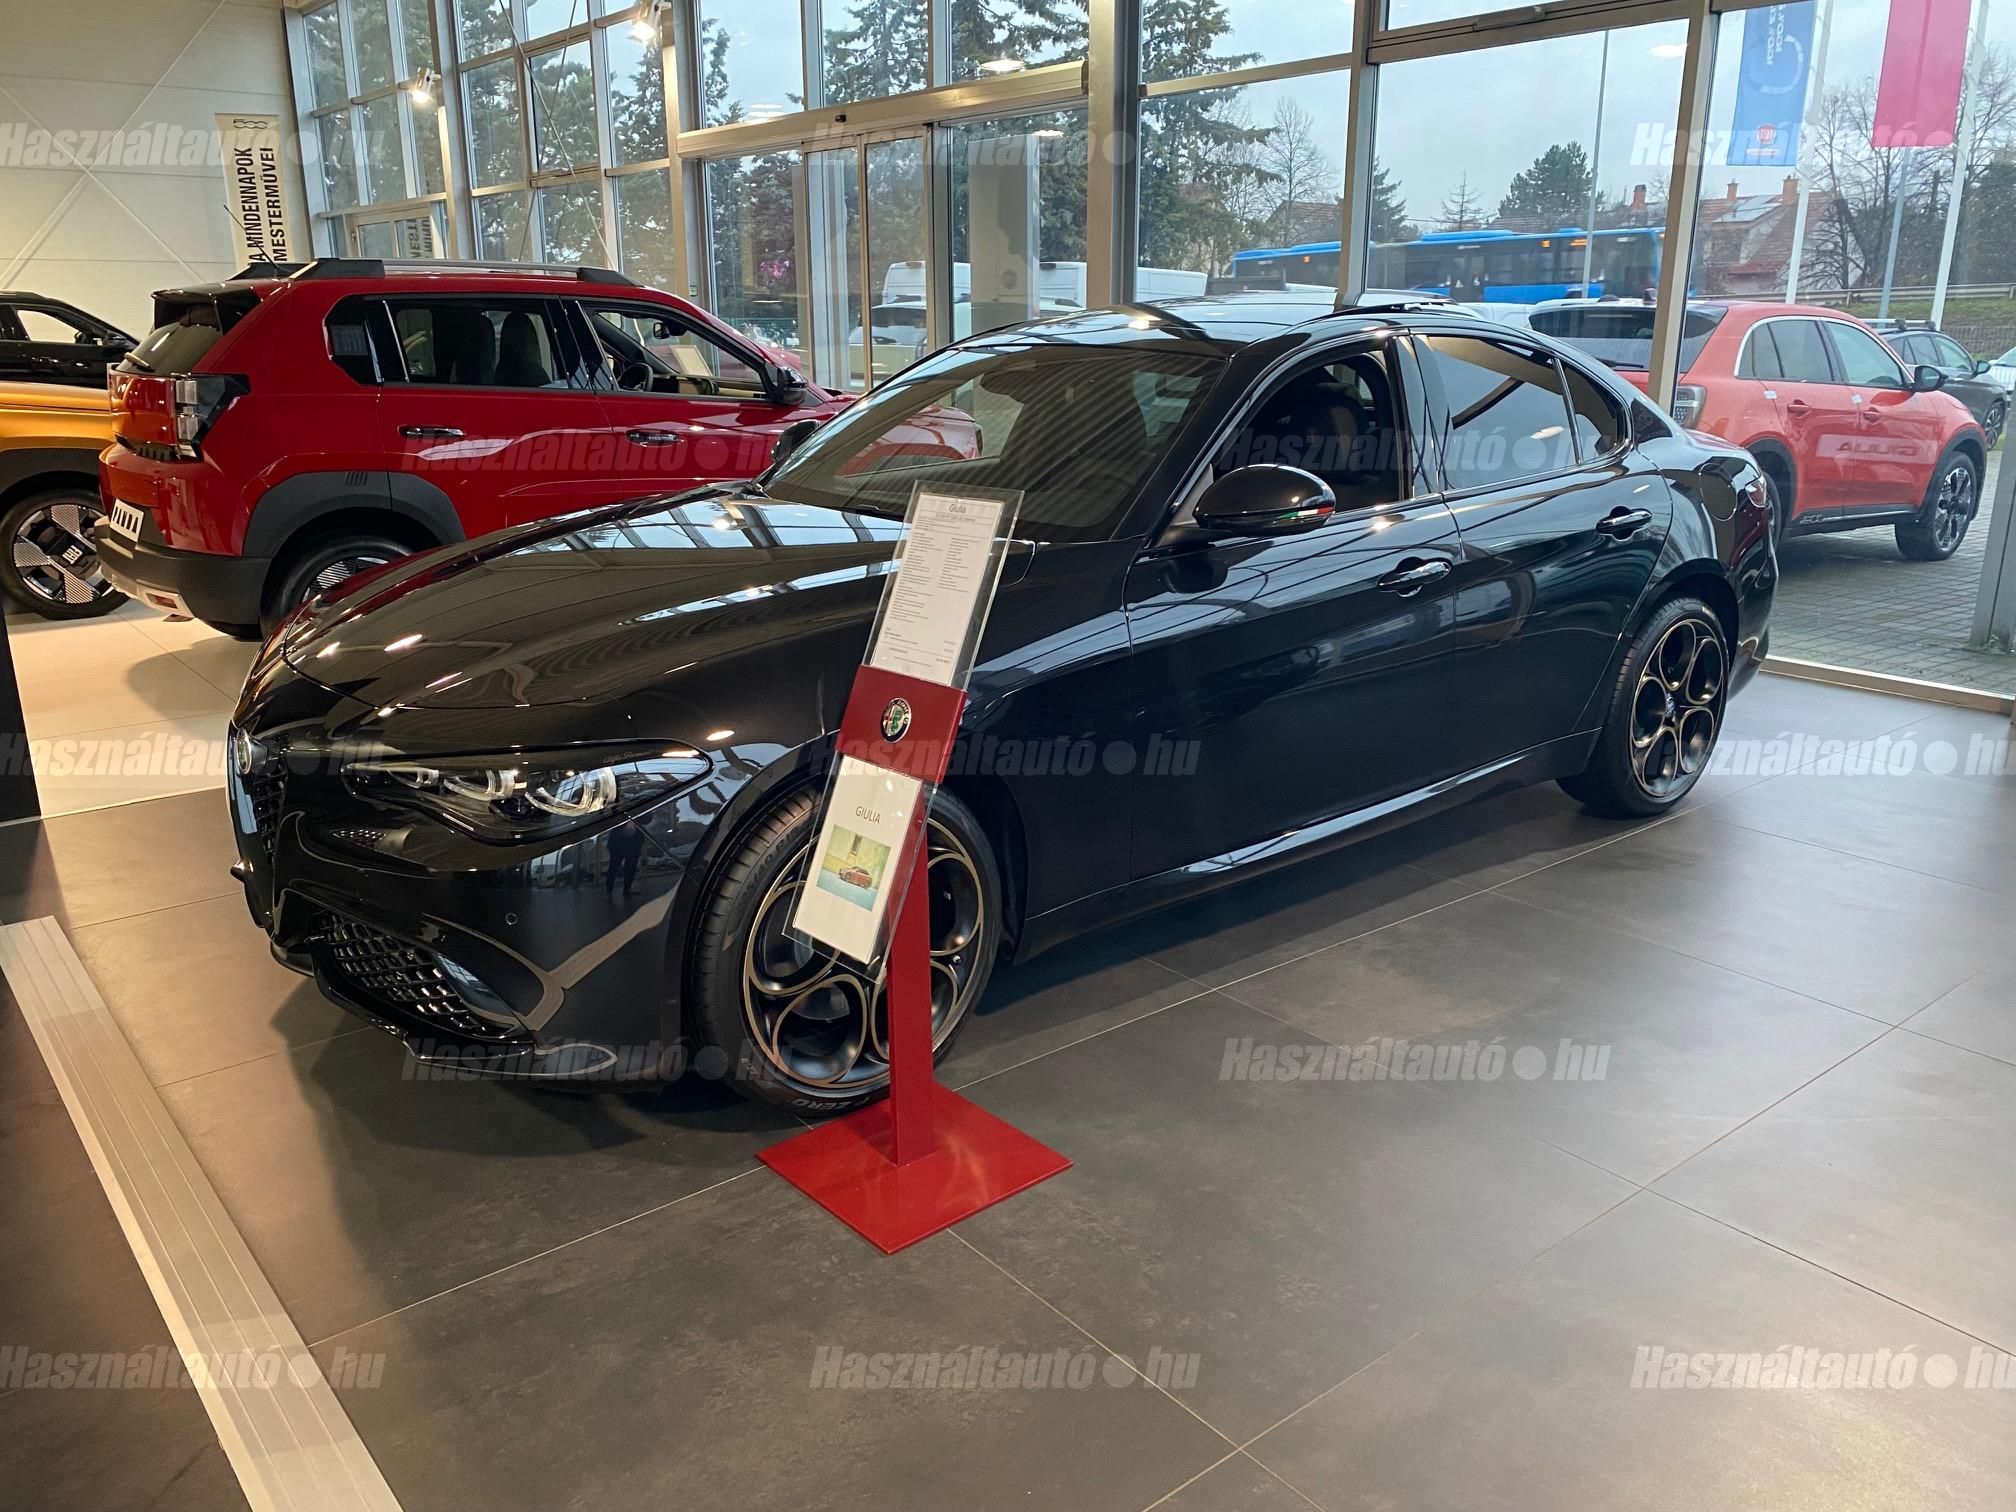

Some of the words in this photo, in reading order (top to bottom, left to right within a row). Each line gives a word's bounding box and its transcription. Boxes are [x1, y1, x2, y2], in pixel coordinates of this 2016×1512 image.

[234, 147, 265, 248] MINDENNAPOK
[112, 506, 139, 534] PANDA
[855, 805, 881, 825] GIULIA
[791, 1098, 852, 1110] ZERO
